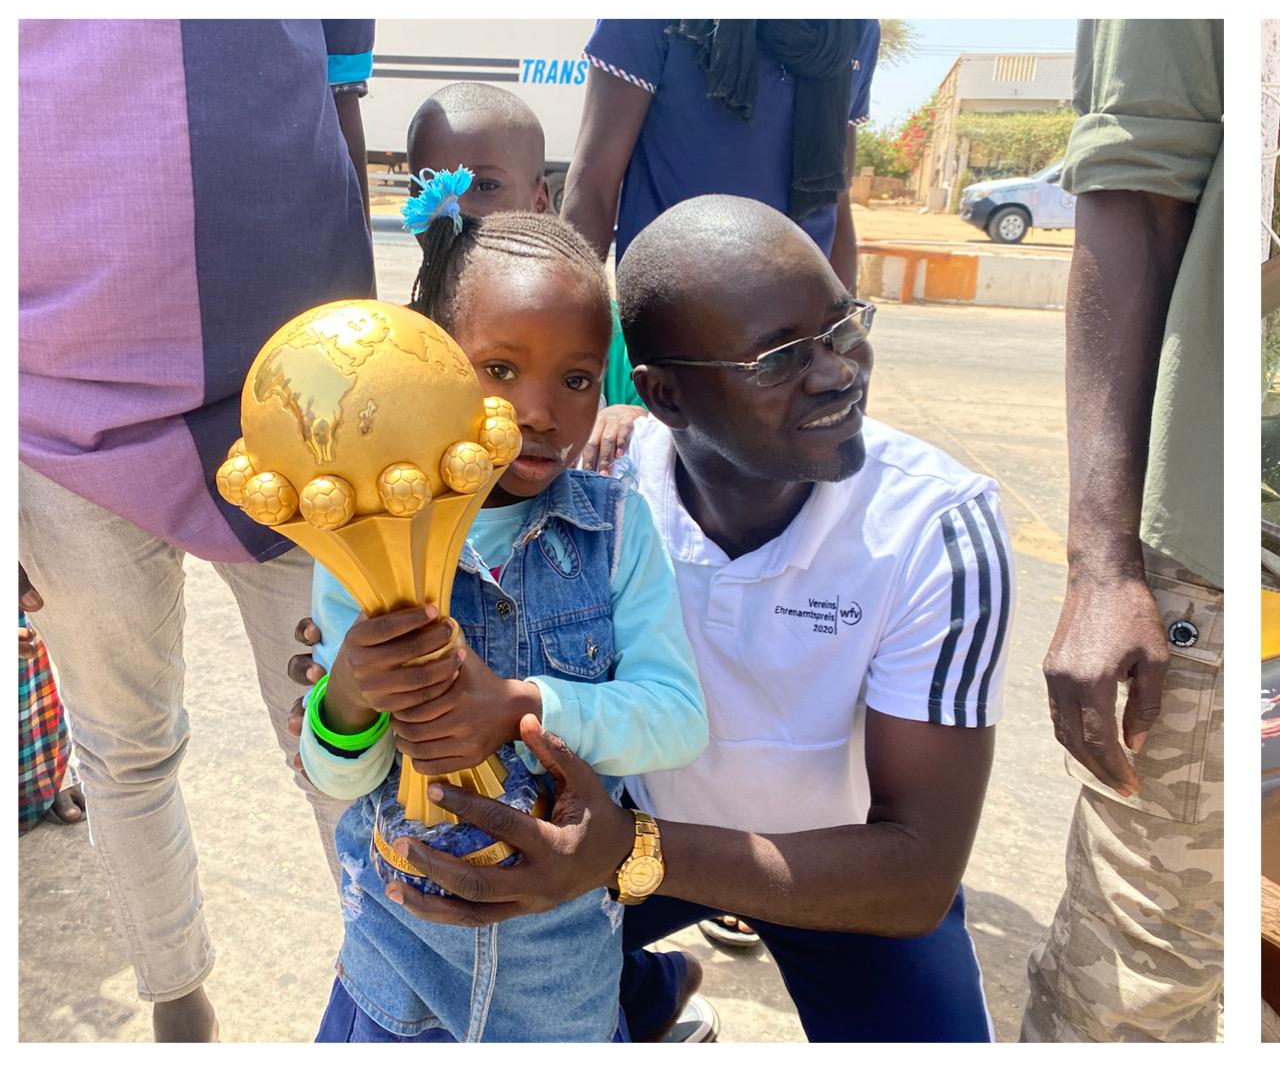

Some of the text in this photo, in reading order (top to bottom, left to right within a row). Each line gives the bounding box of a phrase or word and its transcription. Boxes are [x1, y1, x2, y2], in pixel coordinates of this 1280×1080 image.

[522, 58, 588, 85] TRANS
[808, 598, 837, 610] Vereins
[774, 605, 835, 622] Ehrenamtspreis
[839, 607, 860, 619] wfv
[813, 624, 834, 634] 2020
